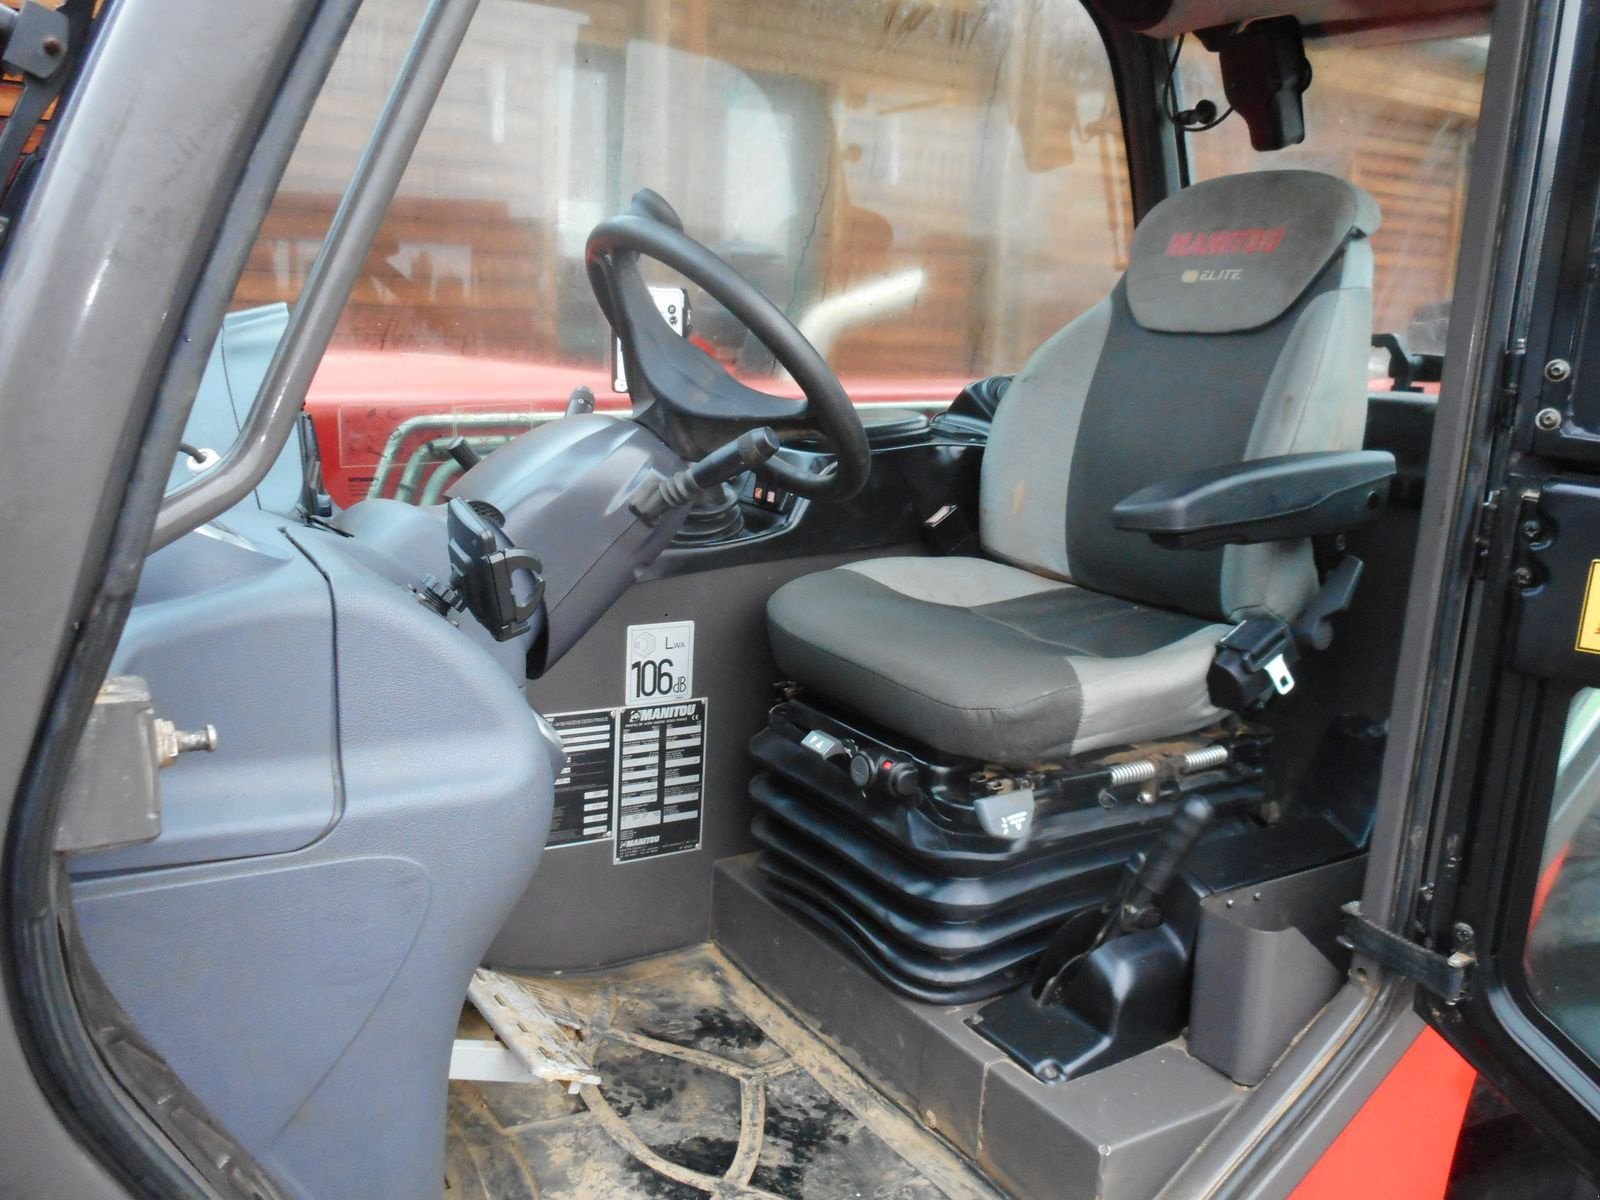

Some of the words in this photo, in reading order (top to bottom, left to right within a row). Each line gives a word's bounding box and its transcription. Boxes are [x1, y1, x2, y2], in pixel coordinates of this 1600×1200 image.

[1166, 225, 1286, 256] MANITOU
[1199, 269, 1243, 281] ELITE
[631, 658, 674, 698] 106
[673, 675, 687, 693] dB
[640, 704, 696, 722] MANITOU
[626, 835, 661, 847] MANITOU
